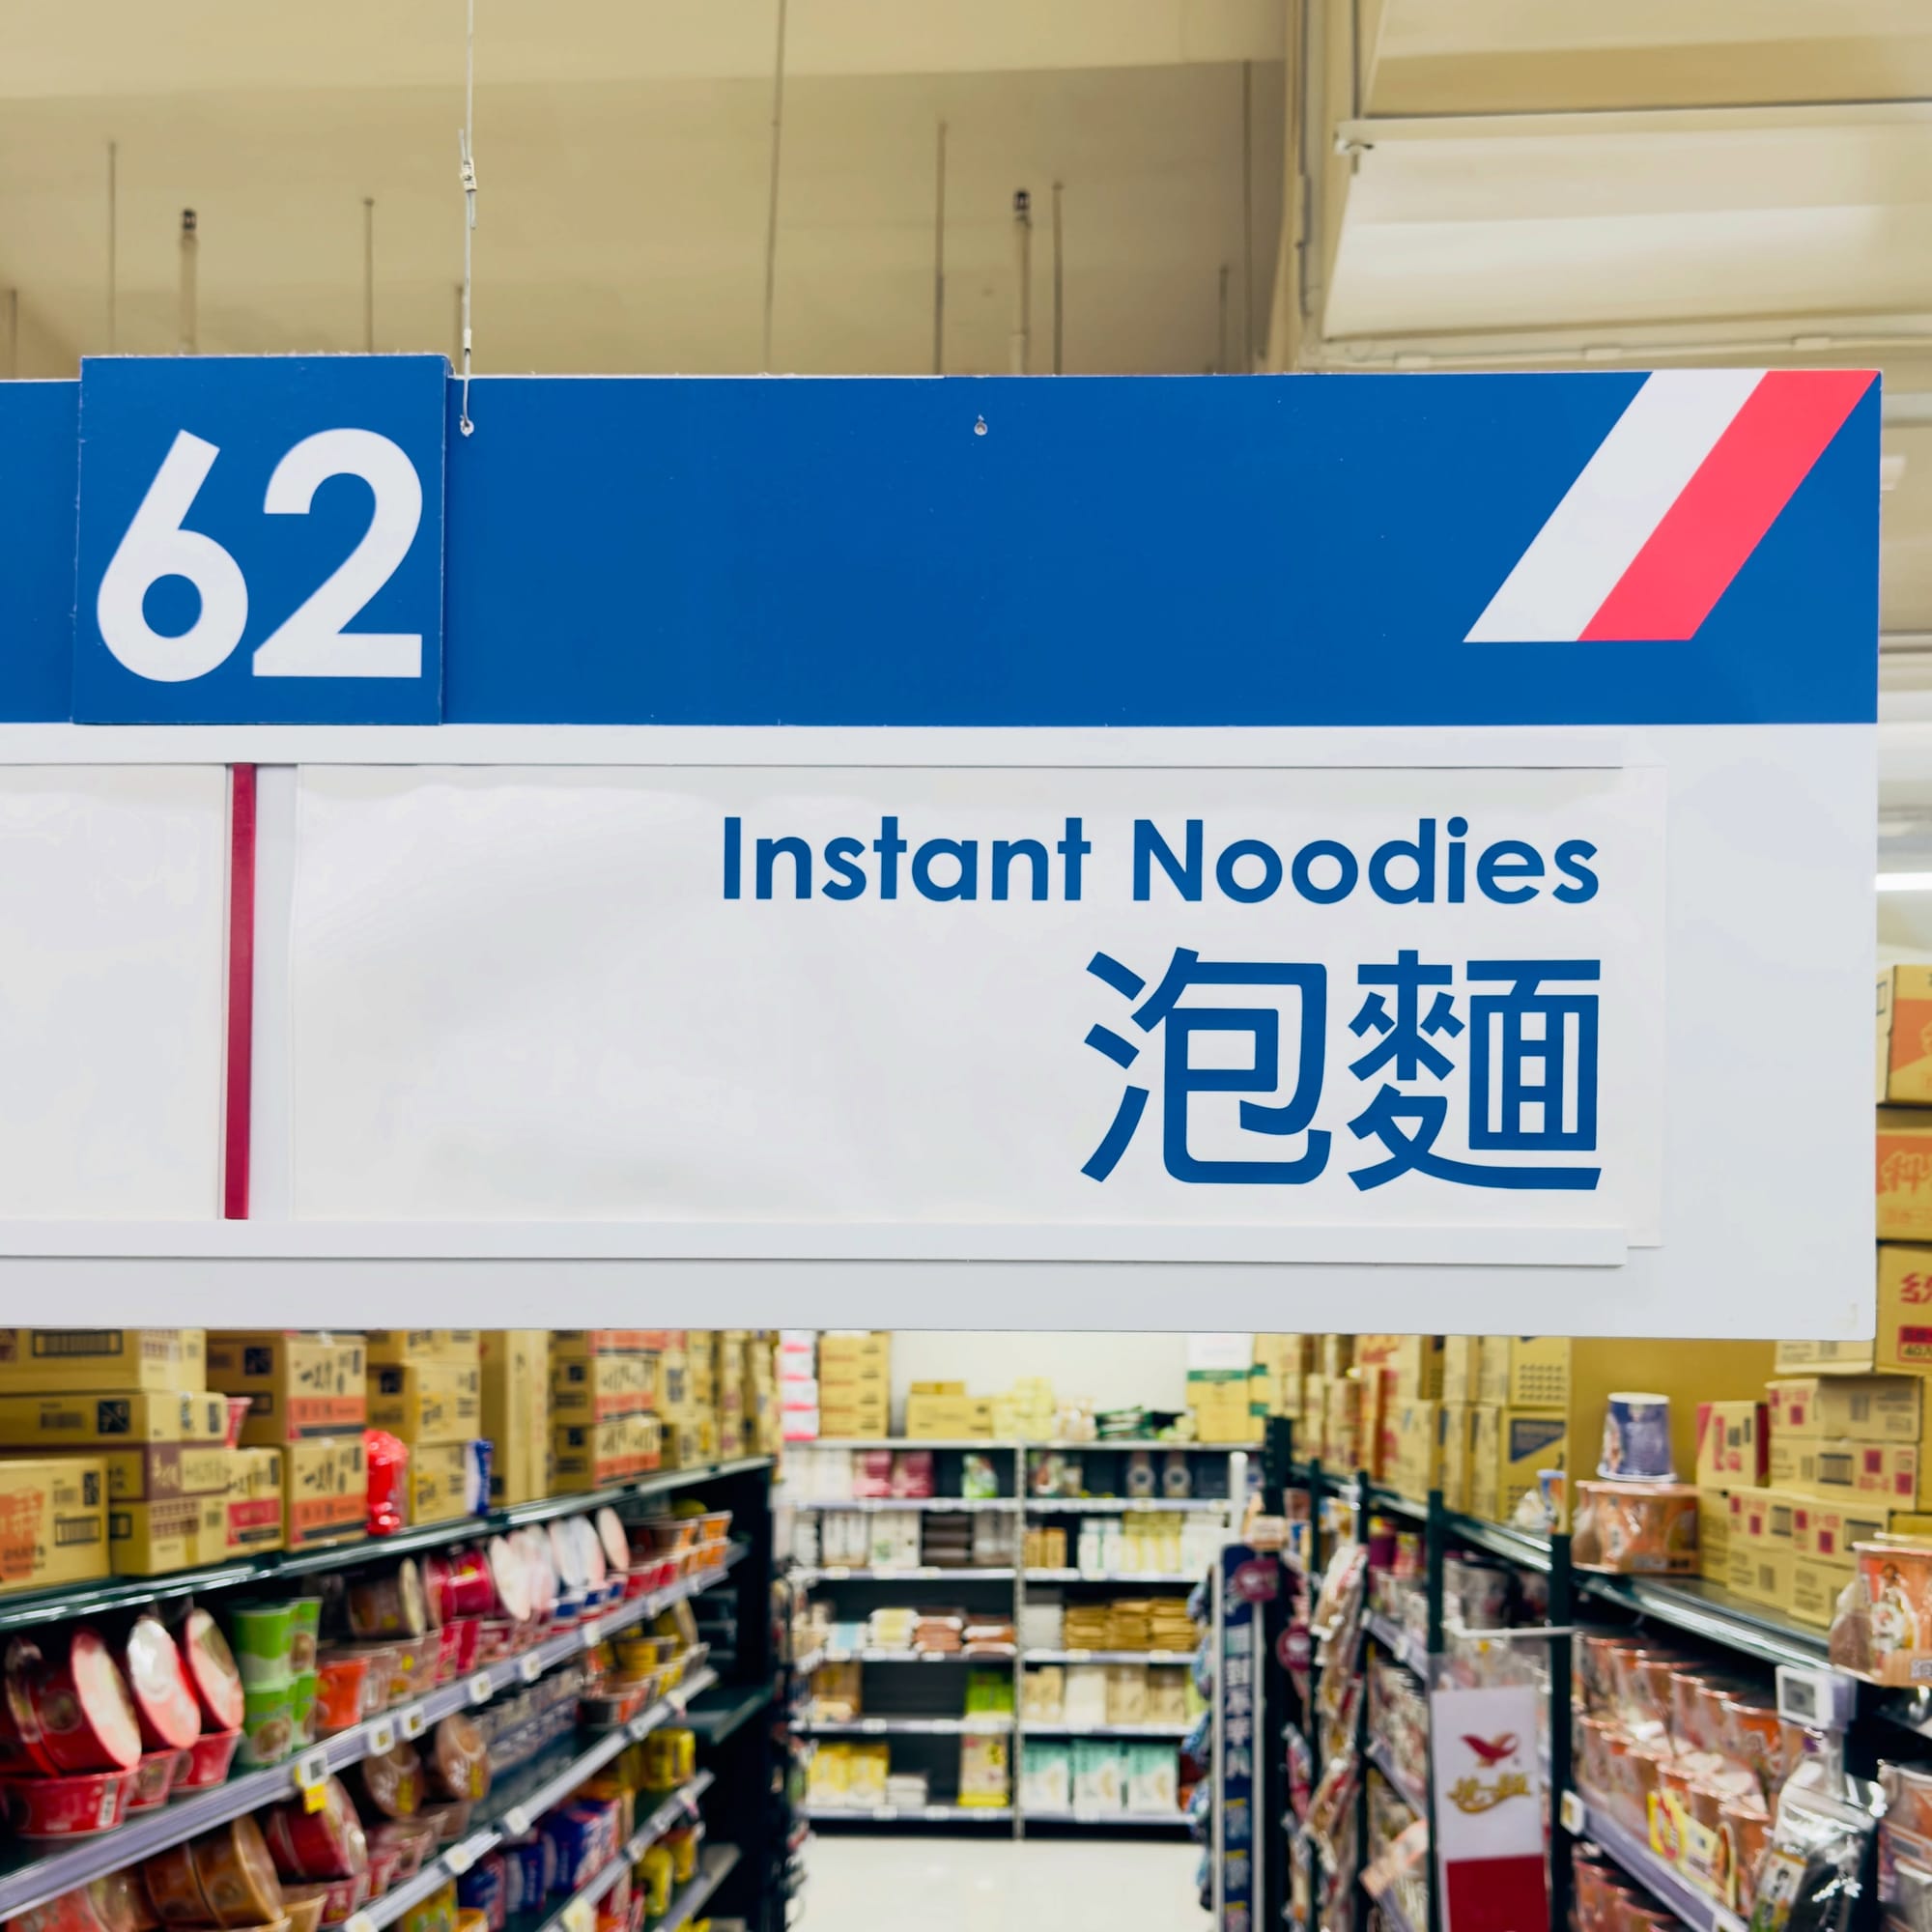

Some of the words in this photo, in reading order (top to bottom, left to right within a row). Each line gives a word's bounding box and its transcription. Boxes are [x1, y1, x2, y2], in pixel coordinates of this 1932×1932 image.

[99, 428, 423, 683] 62
[724, 816, 1092, 902] Instant
[1133, 816, 1600, 905] Noodies
[1081, 947, 1602, 1191] 泡麵
